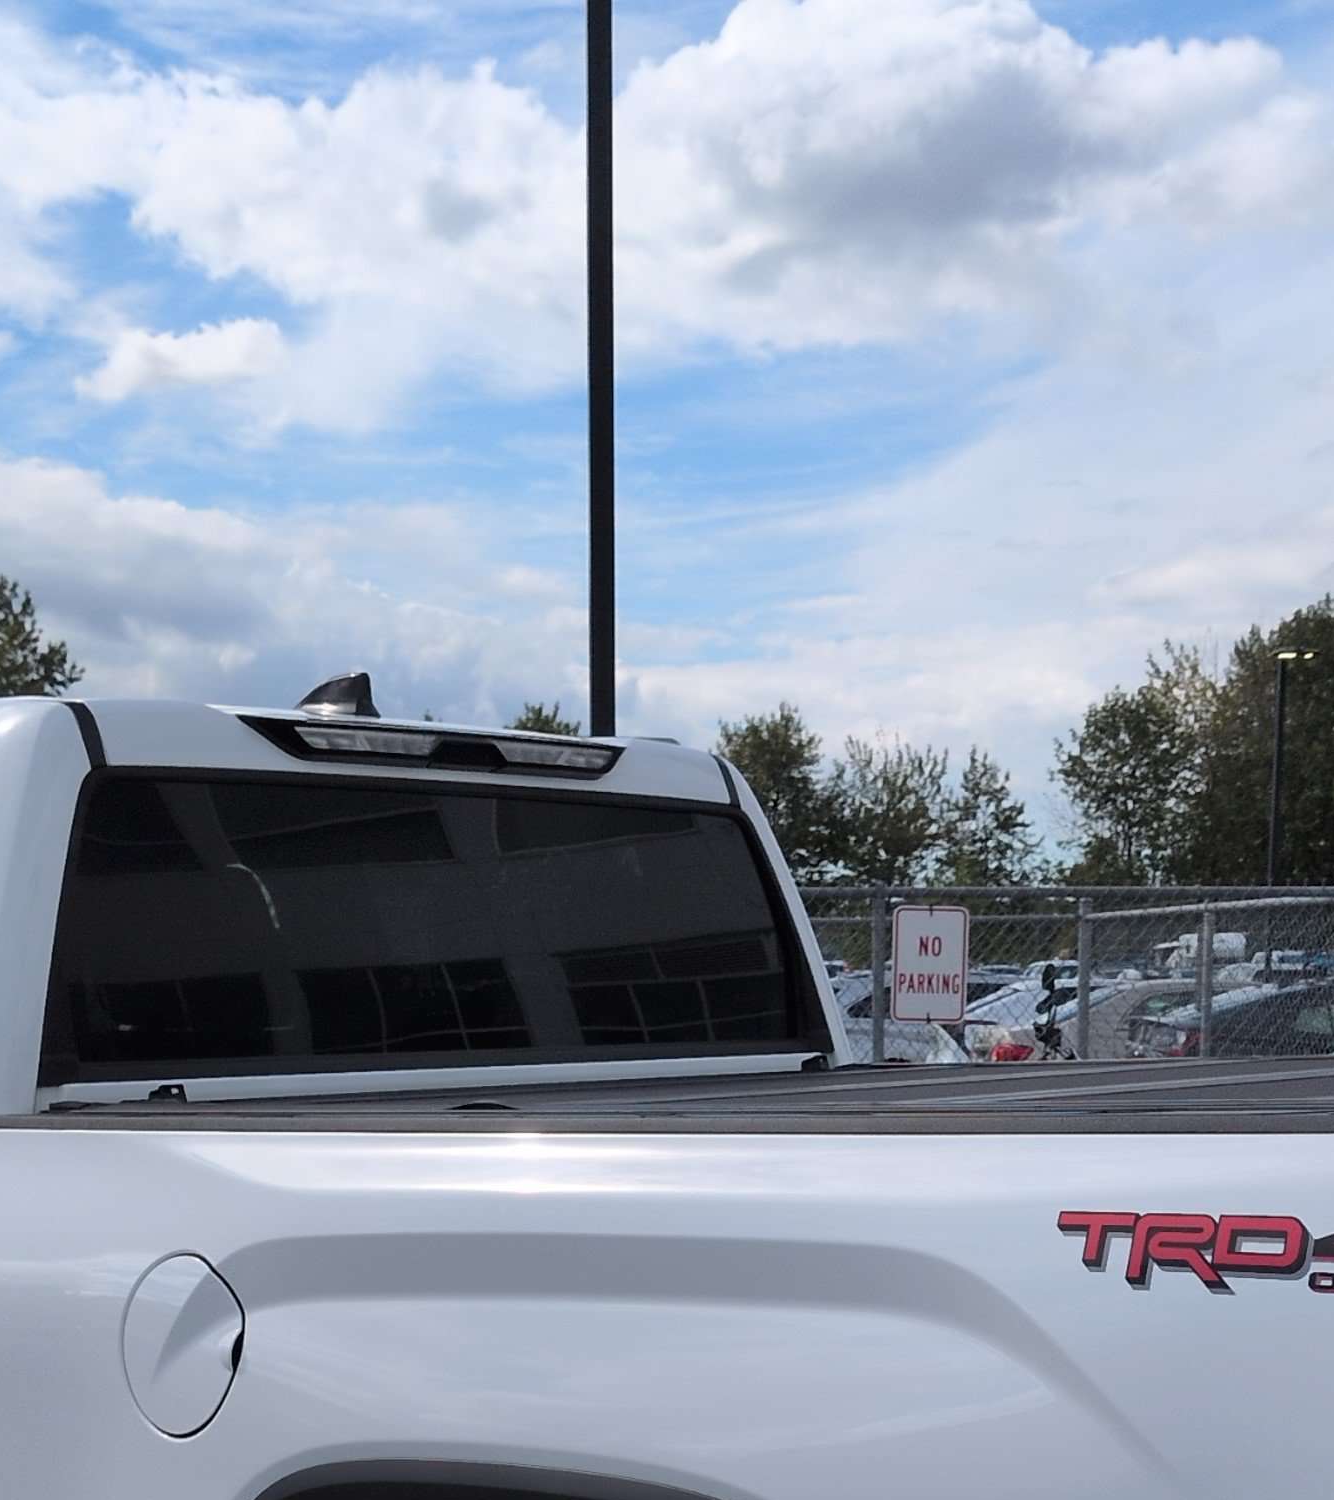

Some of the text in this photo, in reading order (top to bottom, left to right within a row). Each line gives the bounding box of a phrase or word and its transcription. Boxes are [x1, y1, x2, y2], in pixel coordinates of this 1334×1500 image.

[918, 935, 942, 957] NO
[898, 973, 960, 995] PARKING
[1058, 1211, 1312, 1294] TRD
